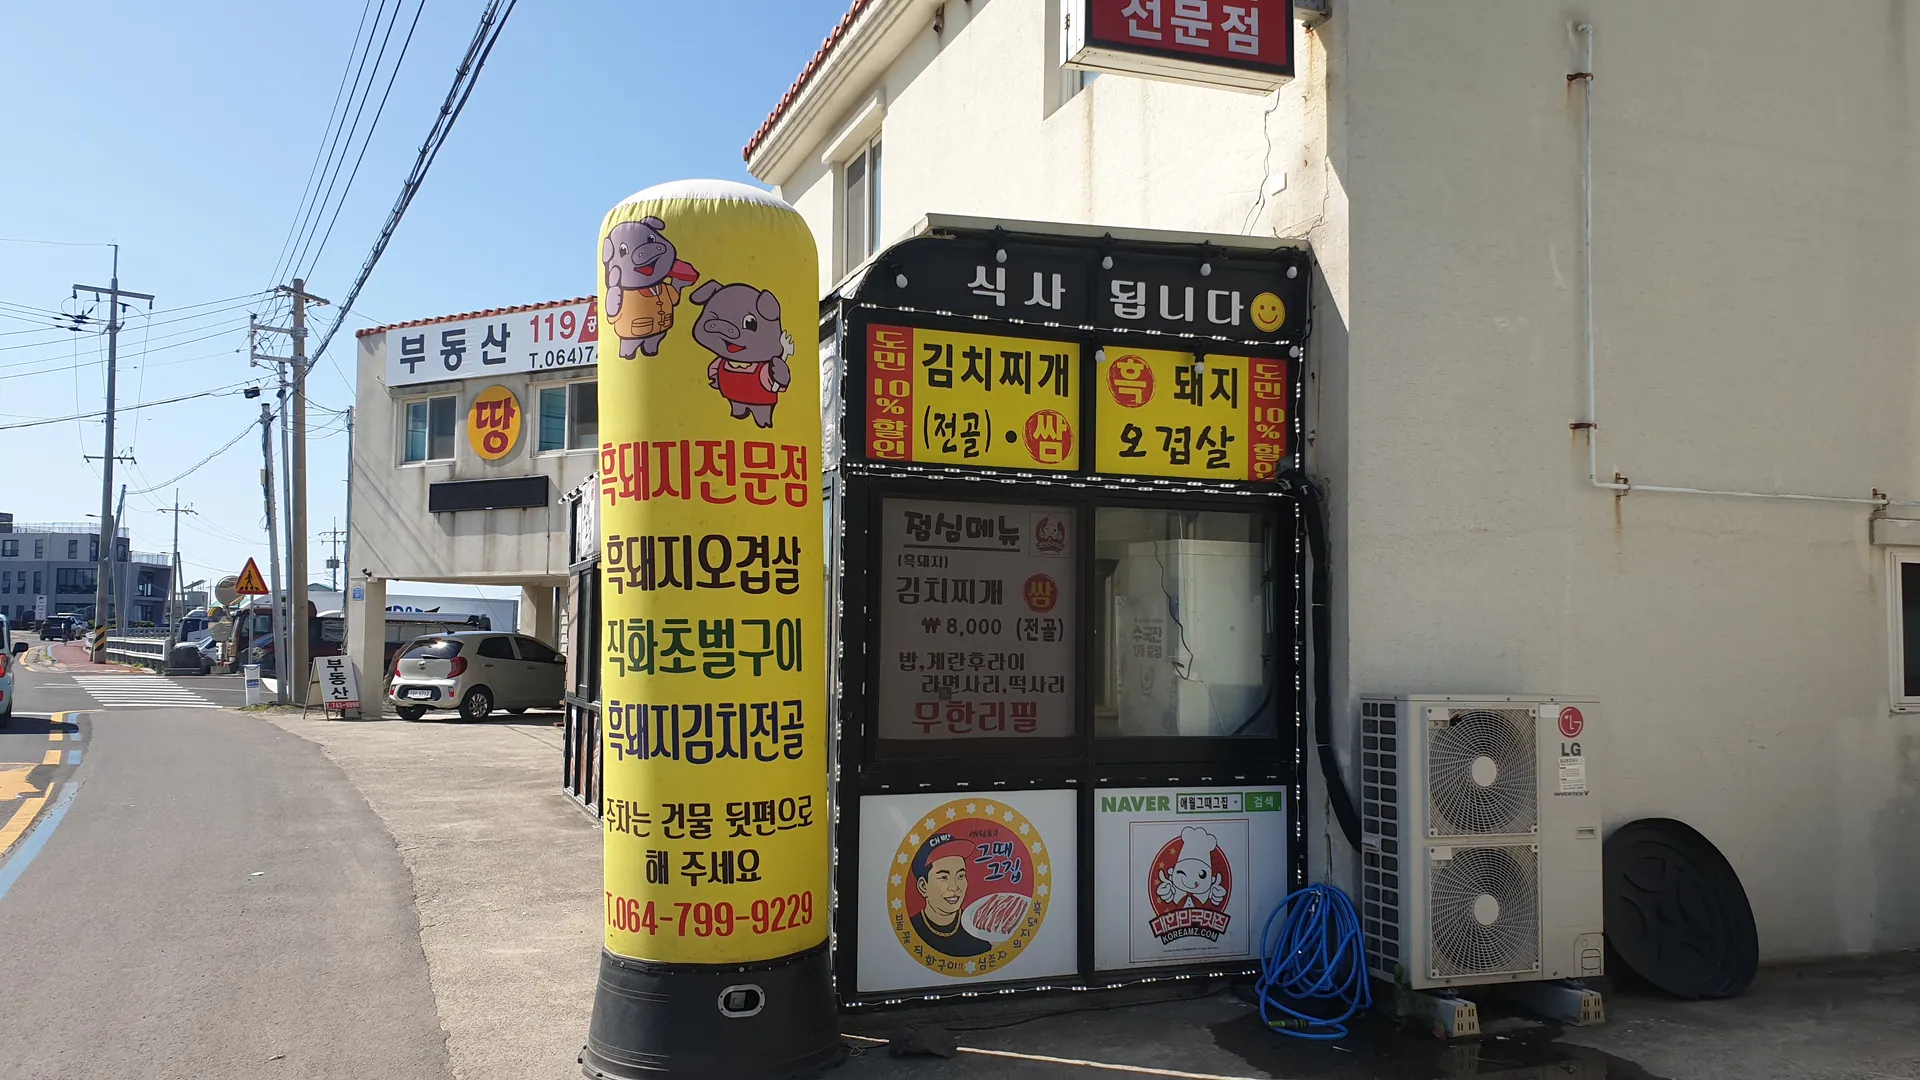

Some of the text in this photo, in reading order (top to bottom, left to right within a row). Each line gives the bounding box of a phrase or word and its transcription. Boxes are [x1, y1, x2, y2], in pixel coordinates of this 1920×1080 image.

[967, 266, 1244, 326] 식사 됩니다
[400, 323, 511, 374] 부동산
[529, 310, 577, 343] 119
[529, 345, 598, 369] T.064)7
[872, 330, 908, 371] 도민
[921, 343, 1069, 398] 김치찌개
[1253, 363, 1282, 400] 도민
[475, 396, 516, 454] 땅
[872, 418, 908, 459] 할인
[923, 404, 991, 459] (전골)
[1118, 423, 1235, 470] 오겹살
[601, 439, 808, 508] 흑돼지전문점
[904, 510, 1020, 546] 점심메뉴
[606, 534, 802, 595] 흑돼지오겹살
[896, 576, 1003, 605] 김치찌개
[607, 618, 802, 680] 직화초벌구이
[1016, 617, 1064, 642] (전골)
[326, 659, 349, 700] 부동산
[608, 700, 805, 765] 흑돼지김치전골
[912, 700, 1038, 734] 무한리필
[1561, 742, 1582, 756] LG
[606, 795, 813, 840] 주차는 건물 뒷편으로
[1101, 795, 1171, 813] NAVER
[1253, 795, 1274, 808] 검색
[645, 848, 762, 887] 해 주세요
[974, 840, 1015, 864] 그때
[605, 890, 813, 937] T.064-799-9229
[1151, 908, 1229, 936] 대한민국맛집
[1161, 927, 1219, 944] KOREAMZ.COM
